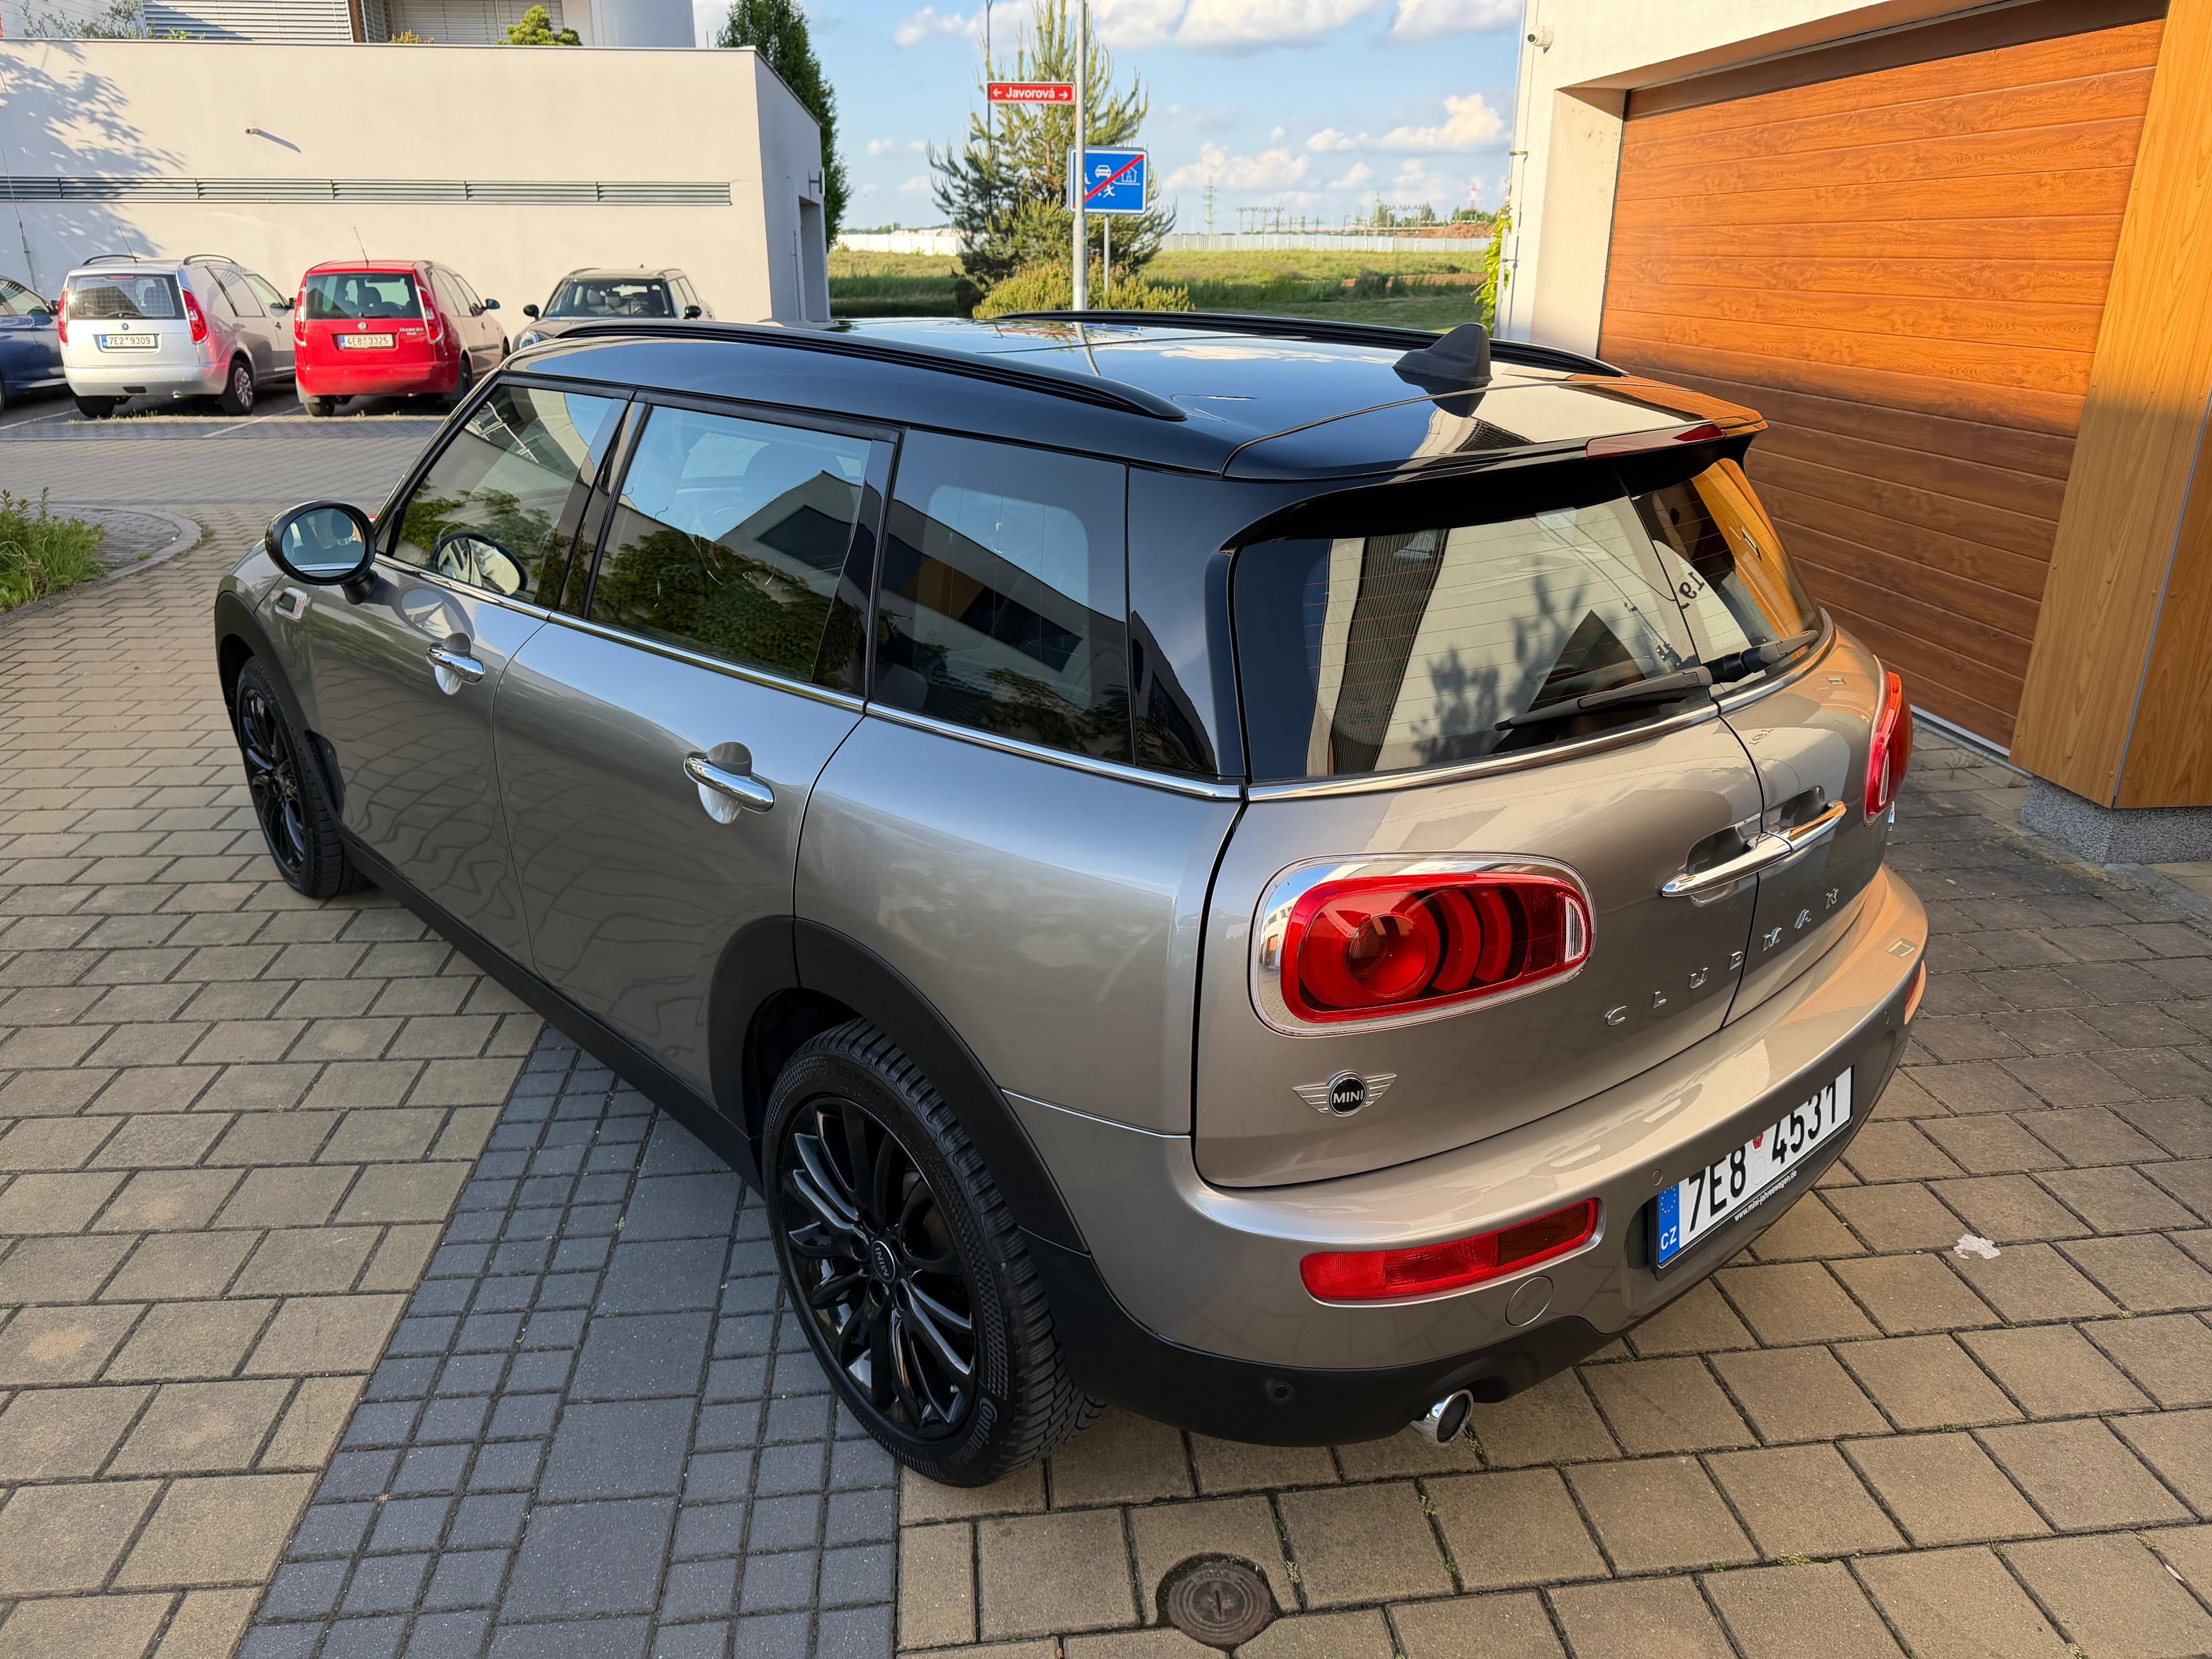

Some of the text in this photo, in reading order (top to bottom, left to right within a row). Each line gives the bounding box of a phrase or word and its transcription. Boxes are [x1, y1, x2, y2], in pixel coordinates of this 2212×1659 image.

[1006, 86, 1055, 99] Javorová
[109, 336, 150, 345] 7E2 9309
[1604, 887, 1839, 1026] CLUBMAN
[1333, 1090, 1364, 1103] MINI
[1688, 1081, 1837, 1233] 7E8 4531
[1735, 1170, 1797, 1222] www.mini-jahreswagen.de
[1661, 1225, 1677, 1250] CZ
[875, 1247, 889, 1277] MINI
